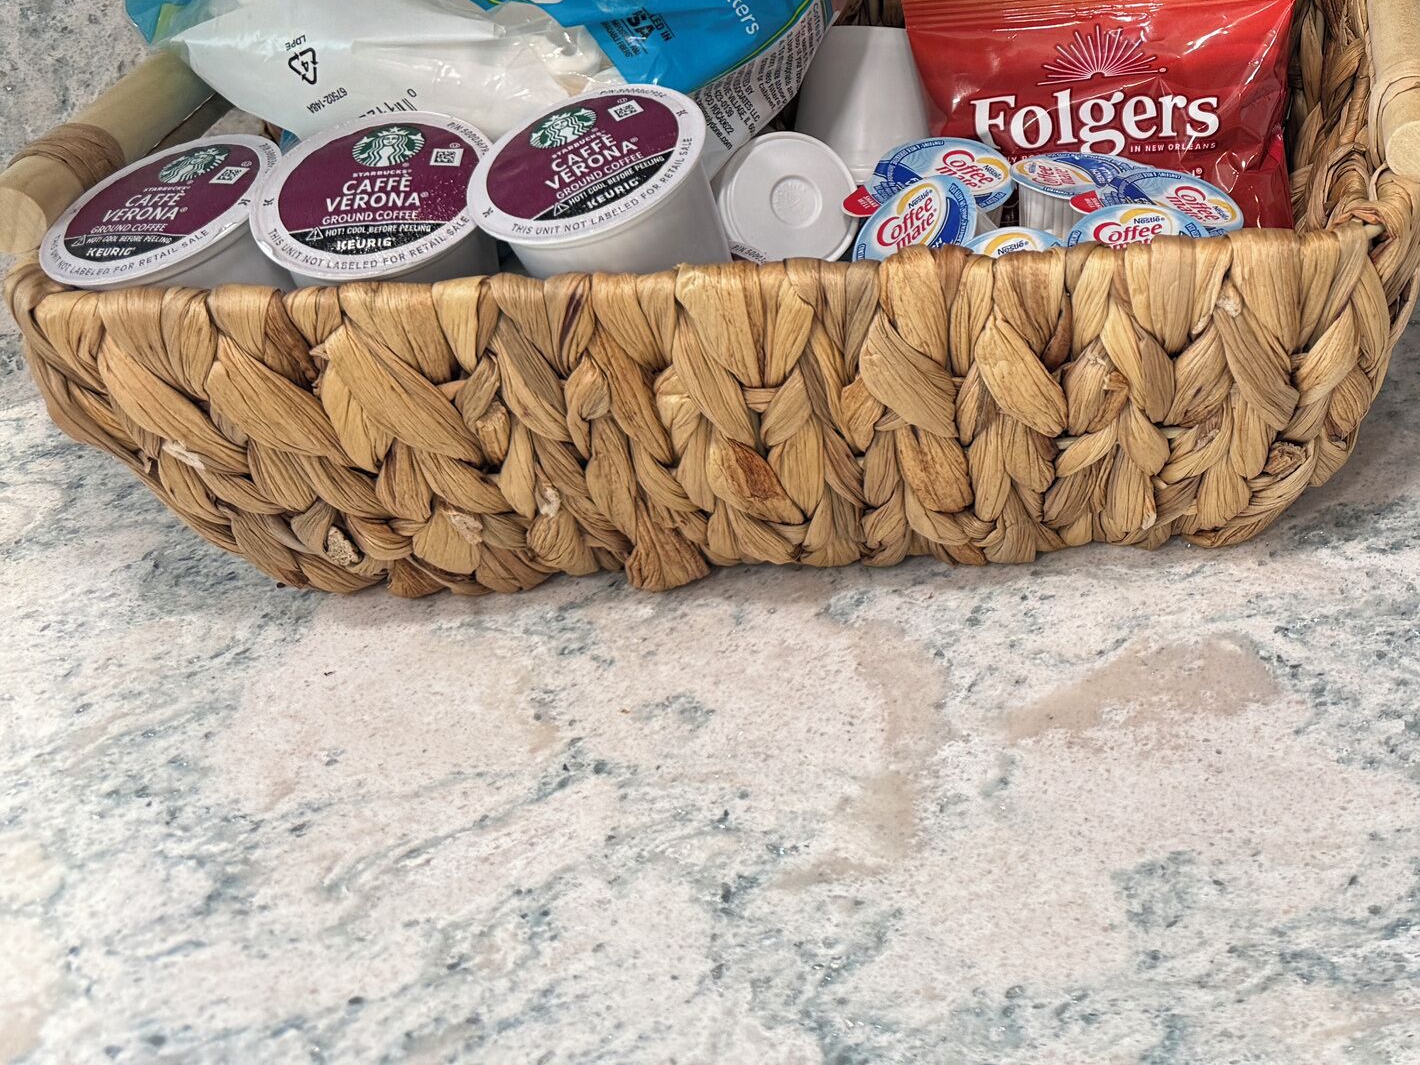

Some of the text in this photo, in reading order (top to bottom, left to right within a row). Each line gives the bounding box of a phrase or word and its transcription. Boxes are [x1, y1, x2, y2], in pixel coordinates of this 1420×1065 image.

[284, 34, 307, 52] LDPE
[306, 86, 348, 114] 67502-148A
[749, 108, 760, 122] LLC
[970, 87, 1221, 157] Folgers
[551, 130, 606, 159] STARBUCKS
[1130, 141, 1217, 153] IN NEW ORLEANS
[352, 169, 410, 178] STARBUCKS
[544, 142, 638, 190] VERONA
[556, 151, 644, 200] GROUND COFFEE
[942, 149, 994, 185] Coffee
[511, 137, 692, 235] THIS UNIT NOT LABELED FOR RETAIL SALE
[568, 155, 665, 206] HOT! COOL BEFORE PEELING
[325, 191, 420, 213] VERONA
[588, 177, 640, 209] KEURIG
[908, 190, 930, 209] Nestlé
[1174, 185, 1220, 222] Coffee
[102, 206, 180, 223] VERONA
[322, 210, 419, 226] GROUND COFFEE
[876, 196, 933, 247] Coffee
[1133, 216, 1161, 225] Nestlé
[90, 223, 168, 234] GROUND COFFEE
[325, 228, 346, 238] HOT!
[346, 226, 367, 235] COOL
[368, 225, 398, 234] BEFORE
[896, 213, 935, 250] mate
[1093, 221, 1163, 245] Coffee
[58, 259, 70, 271] NOT
[69, 265, 110, 276] LABELED
[113, 263, 134, 273] FOR
[138, 246, 178, 267] RETAIL
[181, 229, 209, 248] SALE
[85, 247, 131, 257] KEURIG
[268, 214, 471, 271] THIS UNIT NOT LABELED FOR RETAIL SALE
[336, 237, 392, 251] KEURIG
[997, 238, 1023, 257] Nestlé
